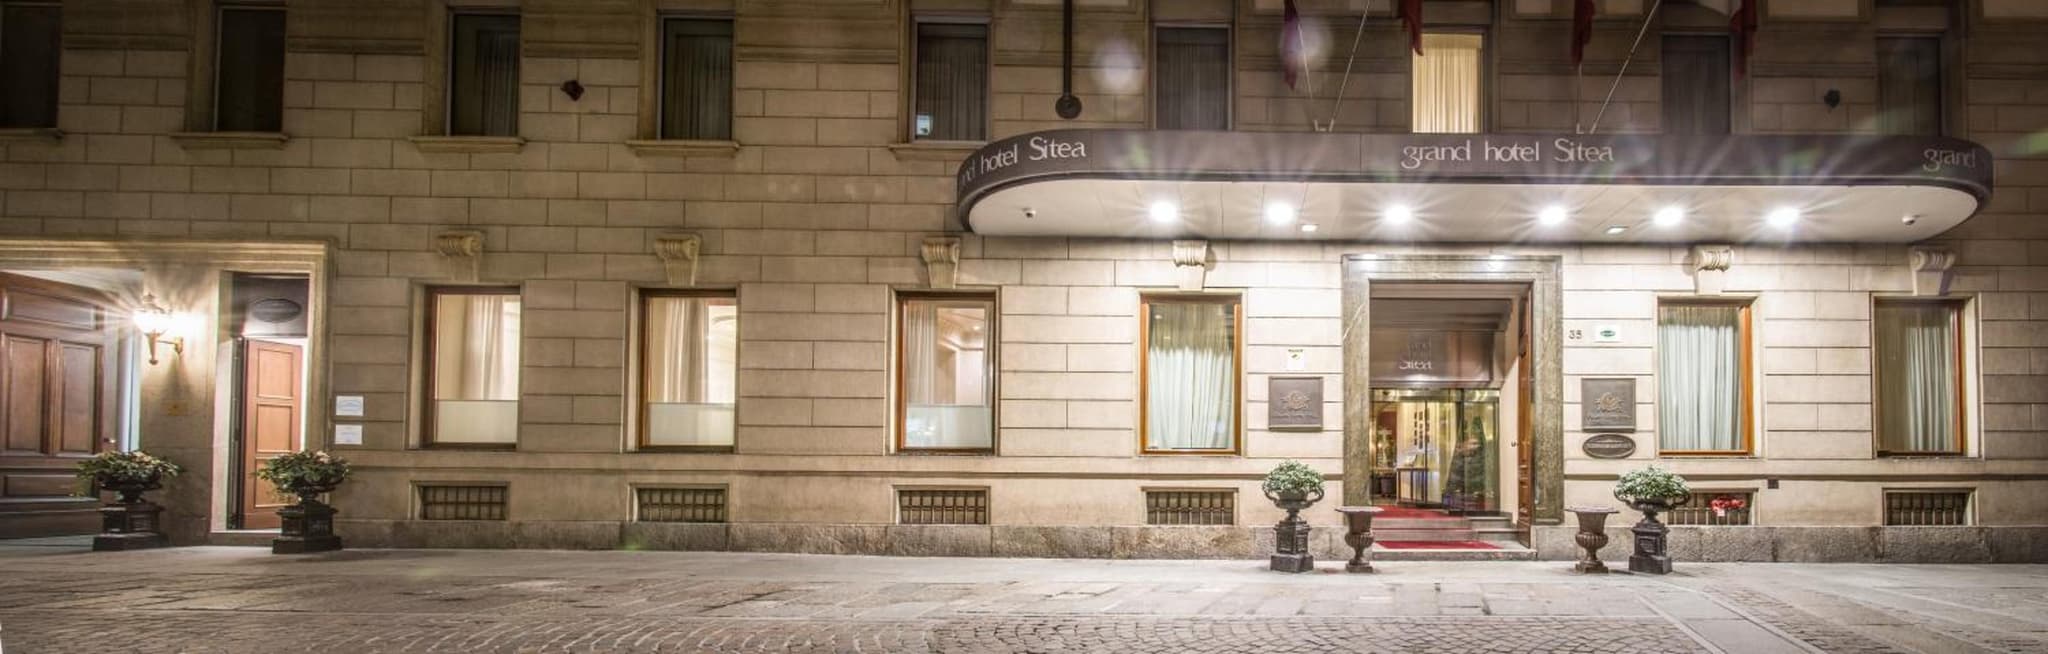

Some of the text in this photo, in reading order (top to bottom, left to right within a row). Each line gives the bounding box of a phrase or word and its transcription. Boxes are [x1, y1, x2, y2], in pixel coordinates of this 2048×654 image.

[980, 143, 1018, 175] hotel
[1029, 136, 1087, 161] Sitea
[1401, 137, 1614, 170] grand hotel Sitea
[1922, 147, 1976, 172] grand
